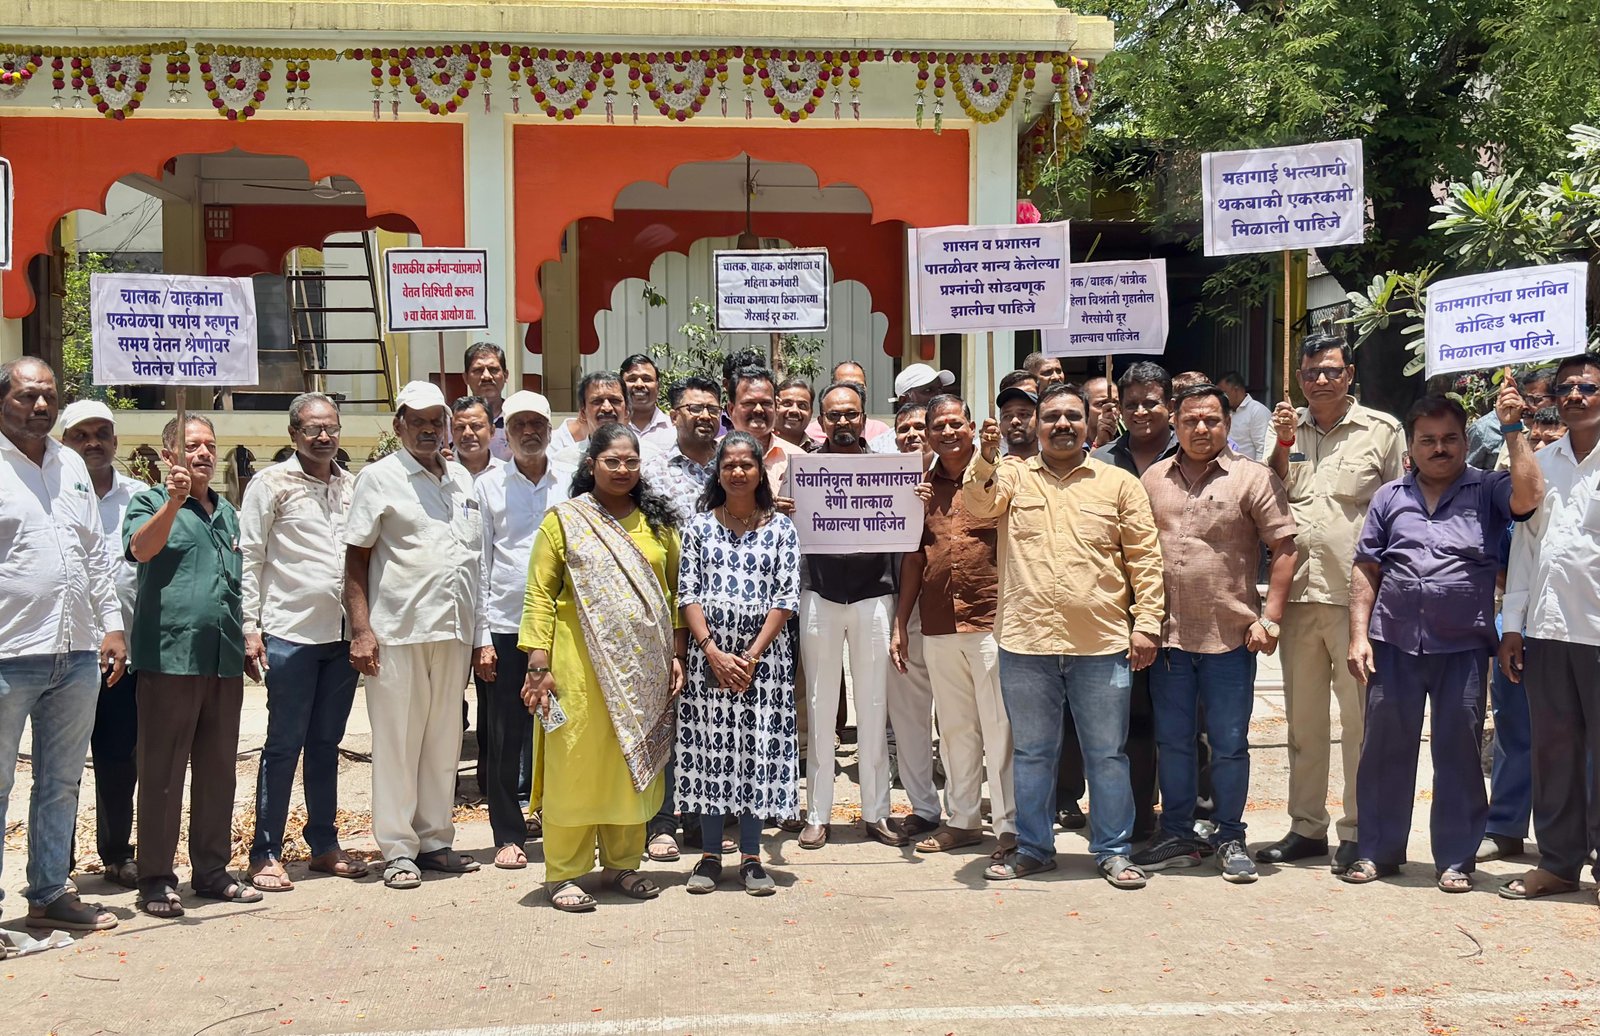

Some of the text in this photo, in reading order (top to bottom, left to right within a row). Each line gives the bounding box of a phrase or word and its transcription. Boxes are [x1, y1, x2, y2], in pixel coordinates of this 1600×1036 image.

[1223, 163, 1278, 185] महागाई
[1218, 183, 1353, 211] थकबाकी एकरकमी
[1232, 212, 1341, 236] मिळाली पाहिजे
[943, 238, 1040, 252] शासन व प्रशासन
[392, 259, 425, 274] शासकीय
[777, 259, 812, 271] कार्यशाळा
[814, 261, 820, 270] व
[925, 256, 1060, 274] पातळीवर मान्य केलेल्या
[402, 283, 420, 297] वेतन
[744, 275, 798, 289] महिला कर्मचारी
[940, 279, 1045, 296] प्रश्नांची सोडवणूक
[724, 293, 745, 304] यांच्या
[747, 296, 779, 304] कामाच्या
[1089, 291, 1119, 305] विश्रांती
[1122, 290, 1154, 307] गृहातील
[1435, 281, 1569, 313] कामगारांचा प्रलंबित
[404, 312, 408, 320] ७
[410, 311, 418, 320] वा
[420, 306, 438, 320] वेतन
[440, 306, 464, 320] आयोग
[951, 299, 1035, 318] झालीच पाहिजे
[107, 308, 239, 336] एकवेळचा पर्याय म्हणून
[772, 312, 780, 325] दूर
[1081, 310, 1126, 326] गैरसोयी दूर
[1456, 310, 1545, 334] कोव्हिड भत्ता
[118, 332, 230, 352] समय वेतन श्रेणीवर
[1070, 329, 1139, 344] झाल्याच पाहिजेत
[1439, 330, 1559, 361] मिळालाच पाहिजे.
[132, 355, 217, 378] घेतलेच पाहिजे
[796, 466, 922, 493] सेवानिवृत्त कामगारांच्या
[825, 489, 893, 509] देणी तात्काळ
[813, 511, 906, 532] मिळाल्या पाहिजेत
